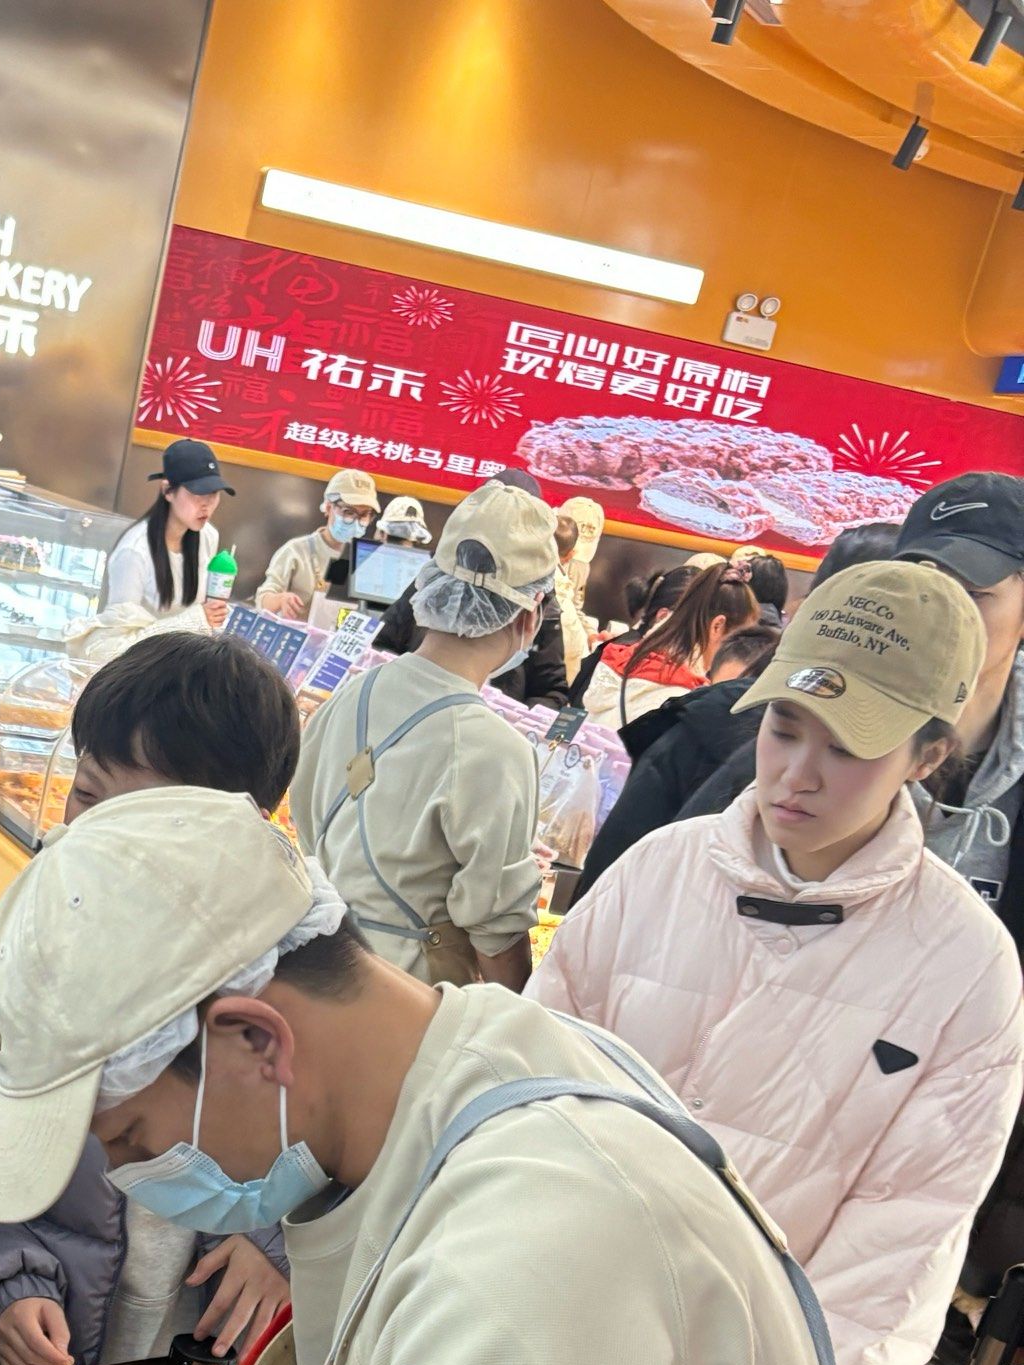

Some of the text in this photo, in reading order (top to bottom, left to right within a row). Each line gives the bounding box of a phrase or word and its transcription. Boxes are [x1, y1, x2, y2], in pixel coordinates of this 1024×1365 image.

[196, 319, 427, 402] UH 祐禾
[499, 347, 764, 424] 现烤更好吃
[505, 320, 772, 398] 匠心好原料
[283, 420, 507, 479] 超级核桃马里奥
[816, 624, 890, 656] Buffalo, NY
[829, 609, 885, 635] Delaware
